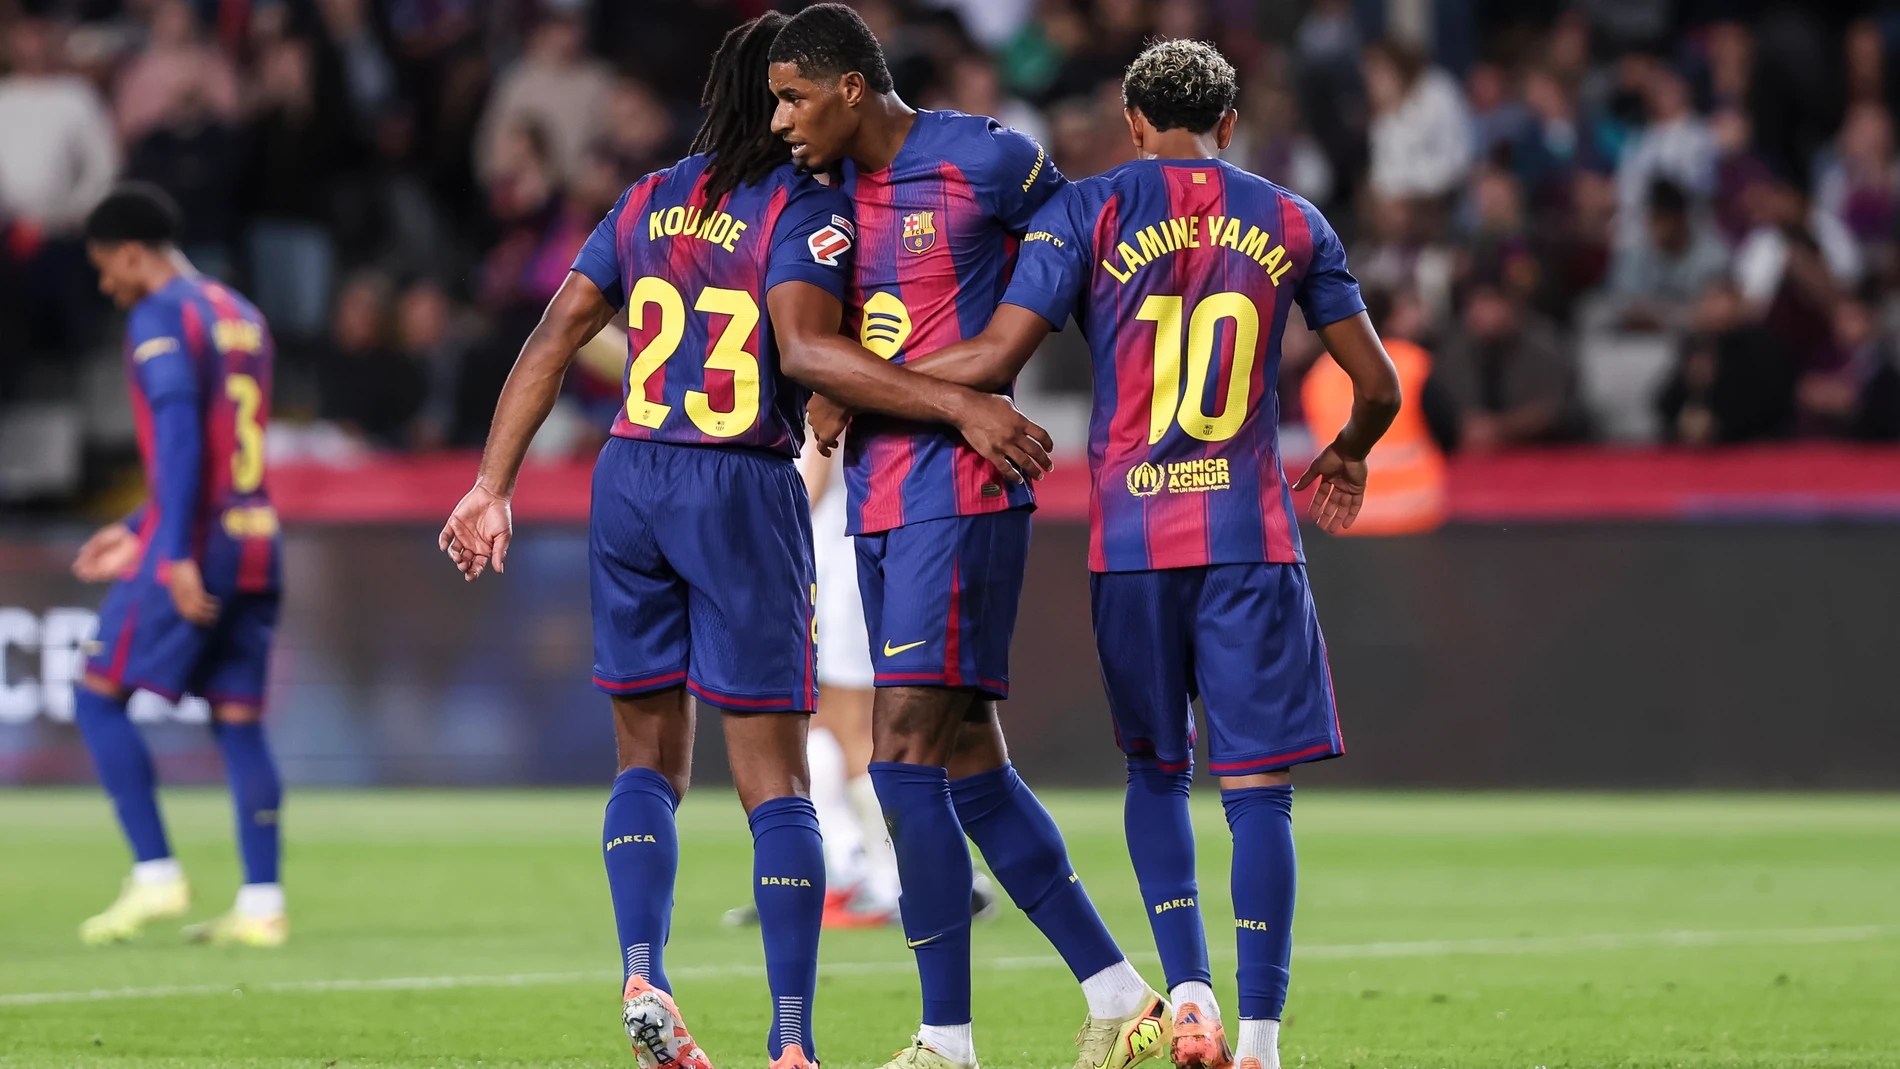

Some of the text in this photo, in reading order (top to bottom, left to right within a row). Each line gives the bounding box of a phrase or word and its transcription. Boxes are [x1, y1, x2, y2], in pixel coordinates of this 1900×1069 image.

[649, 206, 748, 253] KOUNDE
[1102, 216, 1293, 287] LAMINE YAMAL
[626, 276, 760, 437] 23
[1134, 291, 1260, 446] 10
[225, 373, 264, 493] 3
[1168, 459, 1229, 474] UNHCR
[1168, 471, 1230, 488] ACNUR
